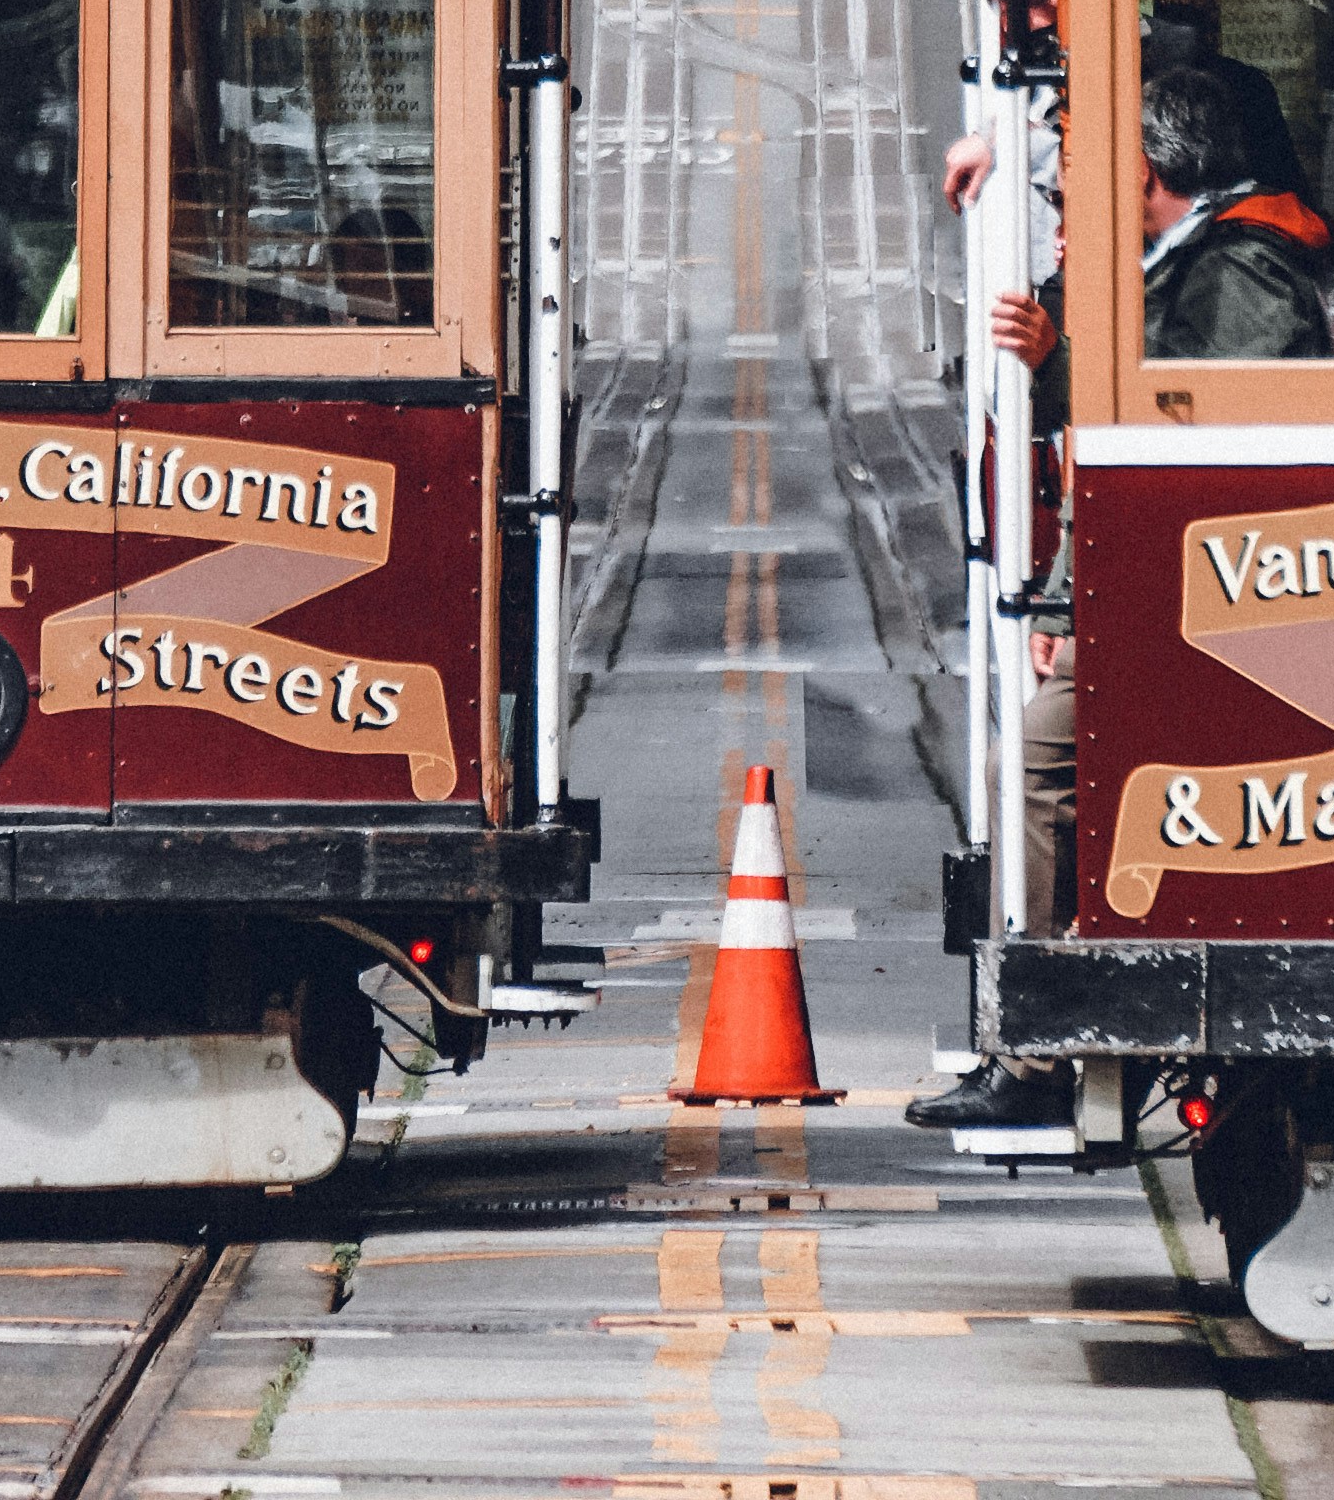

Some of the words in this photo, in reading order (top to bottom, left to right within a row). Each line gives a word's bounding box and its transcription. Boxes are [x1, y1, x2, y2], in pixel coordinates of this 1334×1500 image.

[18, 439, 381, 536] California
[95, 628, 407, 738] Streets
[1160, 776, 1223, 852] &
